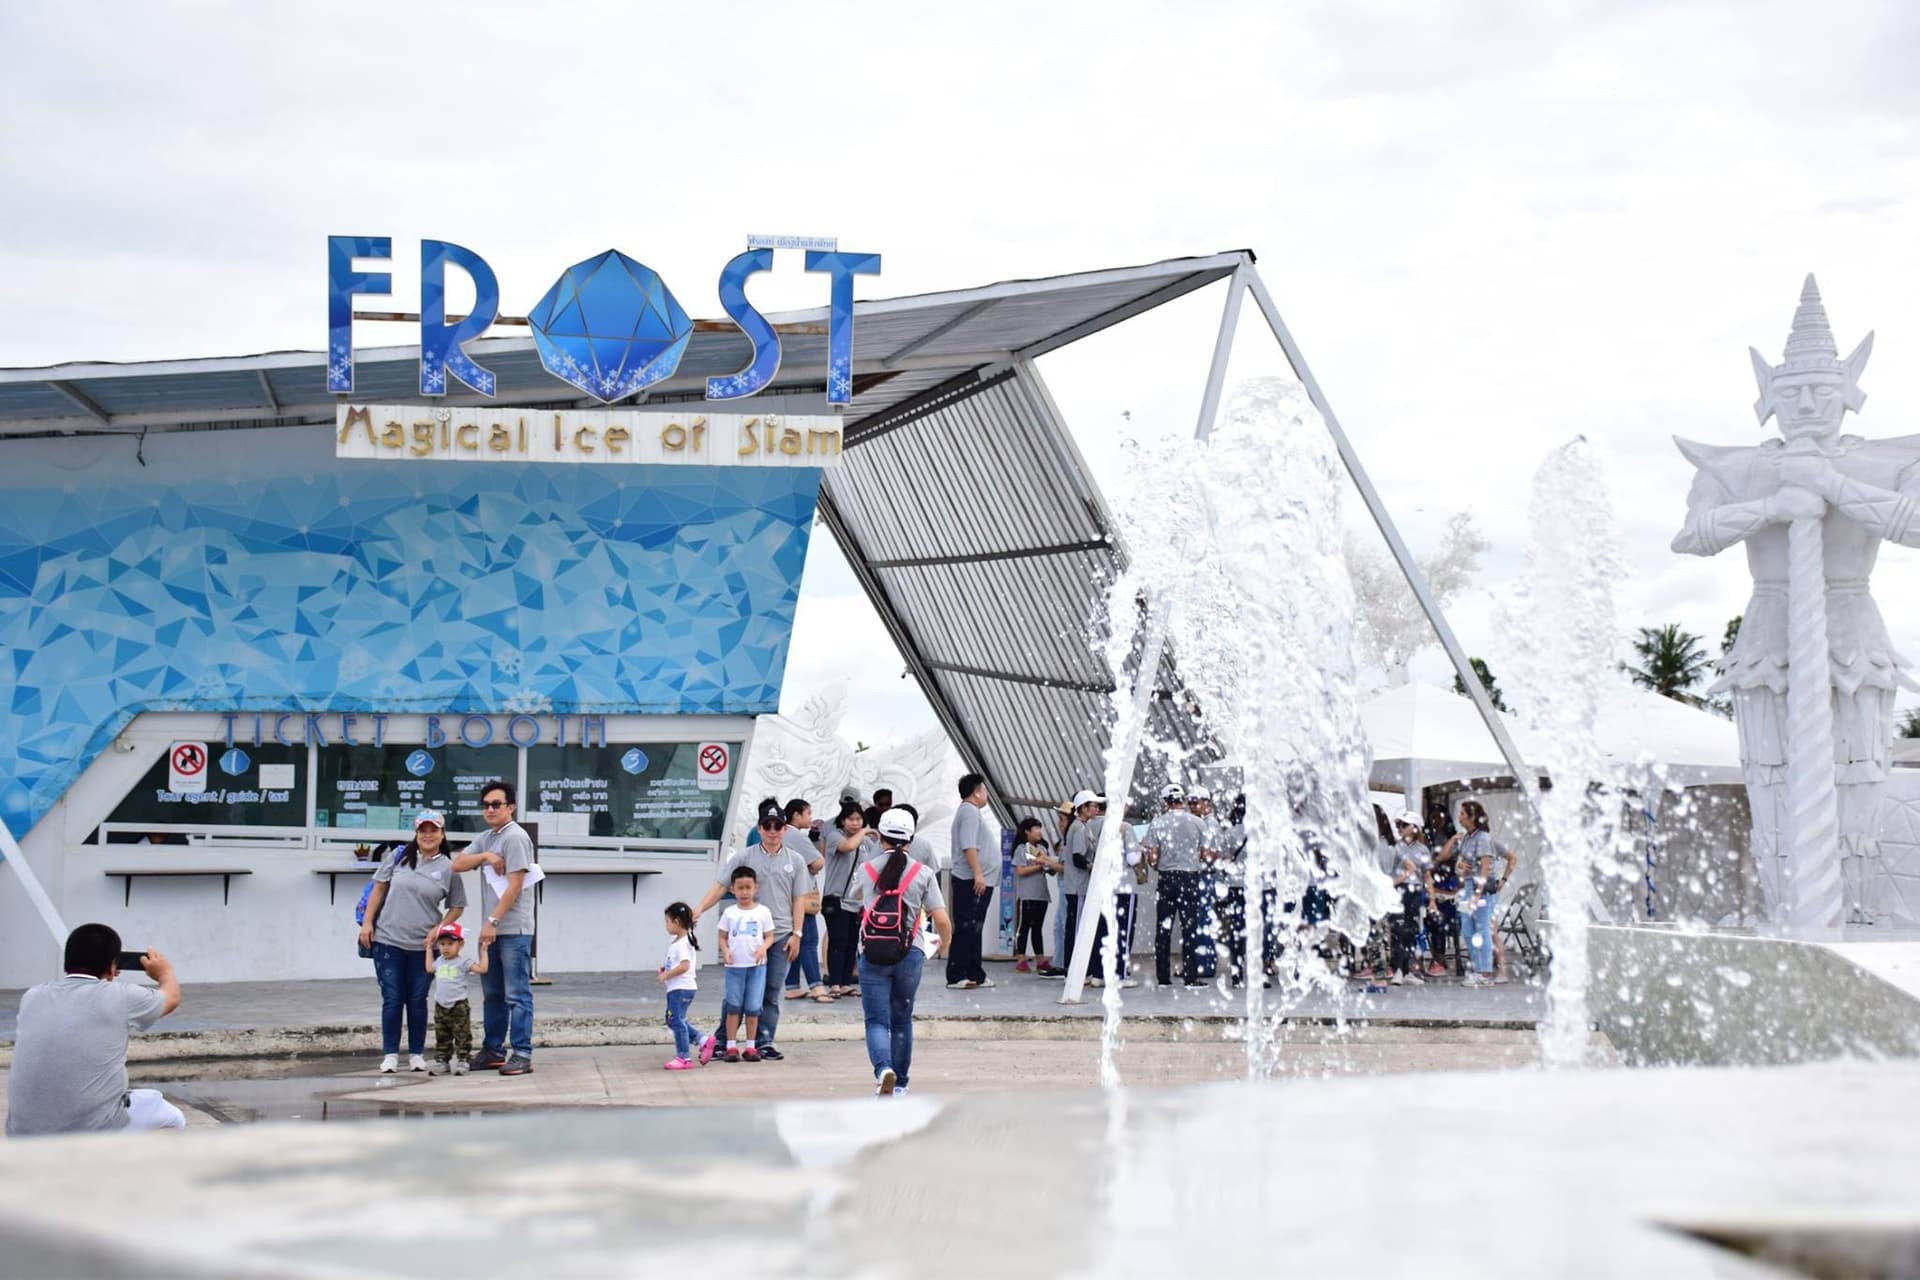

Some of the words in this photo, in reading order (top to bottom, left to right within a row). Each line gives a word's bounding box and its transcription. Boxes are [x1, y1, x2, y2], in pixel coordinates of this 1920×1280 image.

[338, 405, 528, 456] Magical
[552, 413, 632, 455] Ice
[661, 415, 707, 452] of
[737, 413, 843, 457] Siam
[222, 713, 389, 748] TICKET
[425, 714, 607, 749] BOOTH
[412, 754, 426, 770] 2
[628, 753, 640, 769] 3
